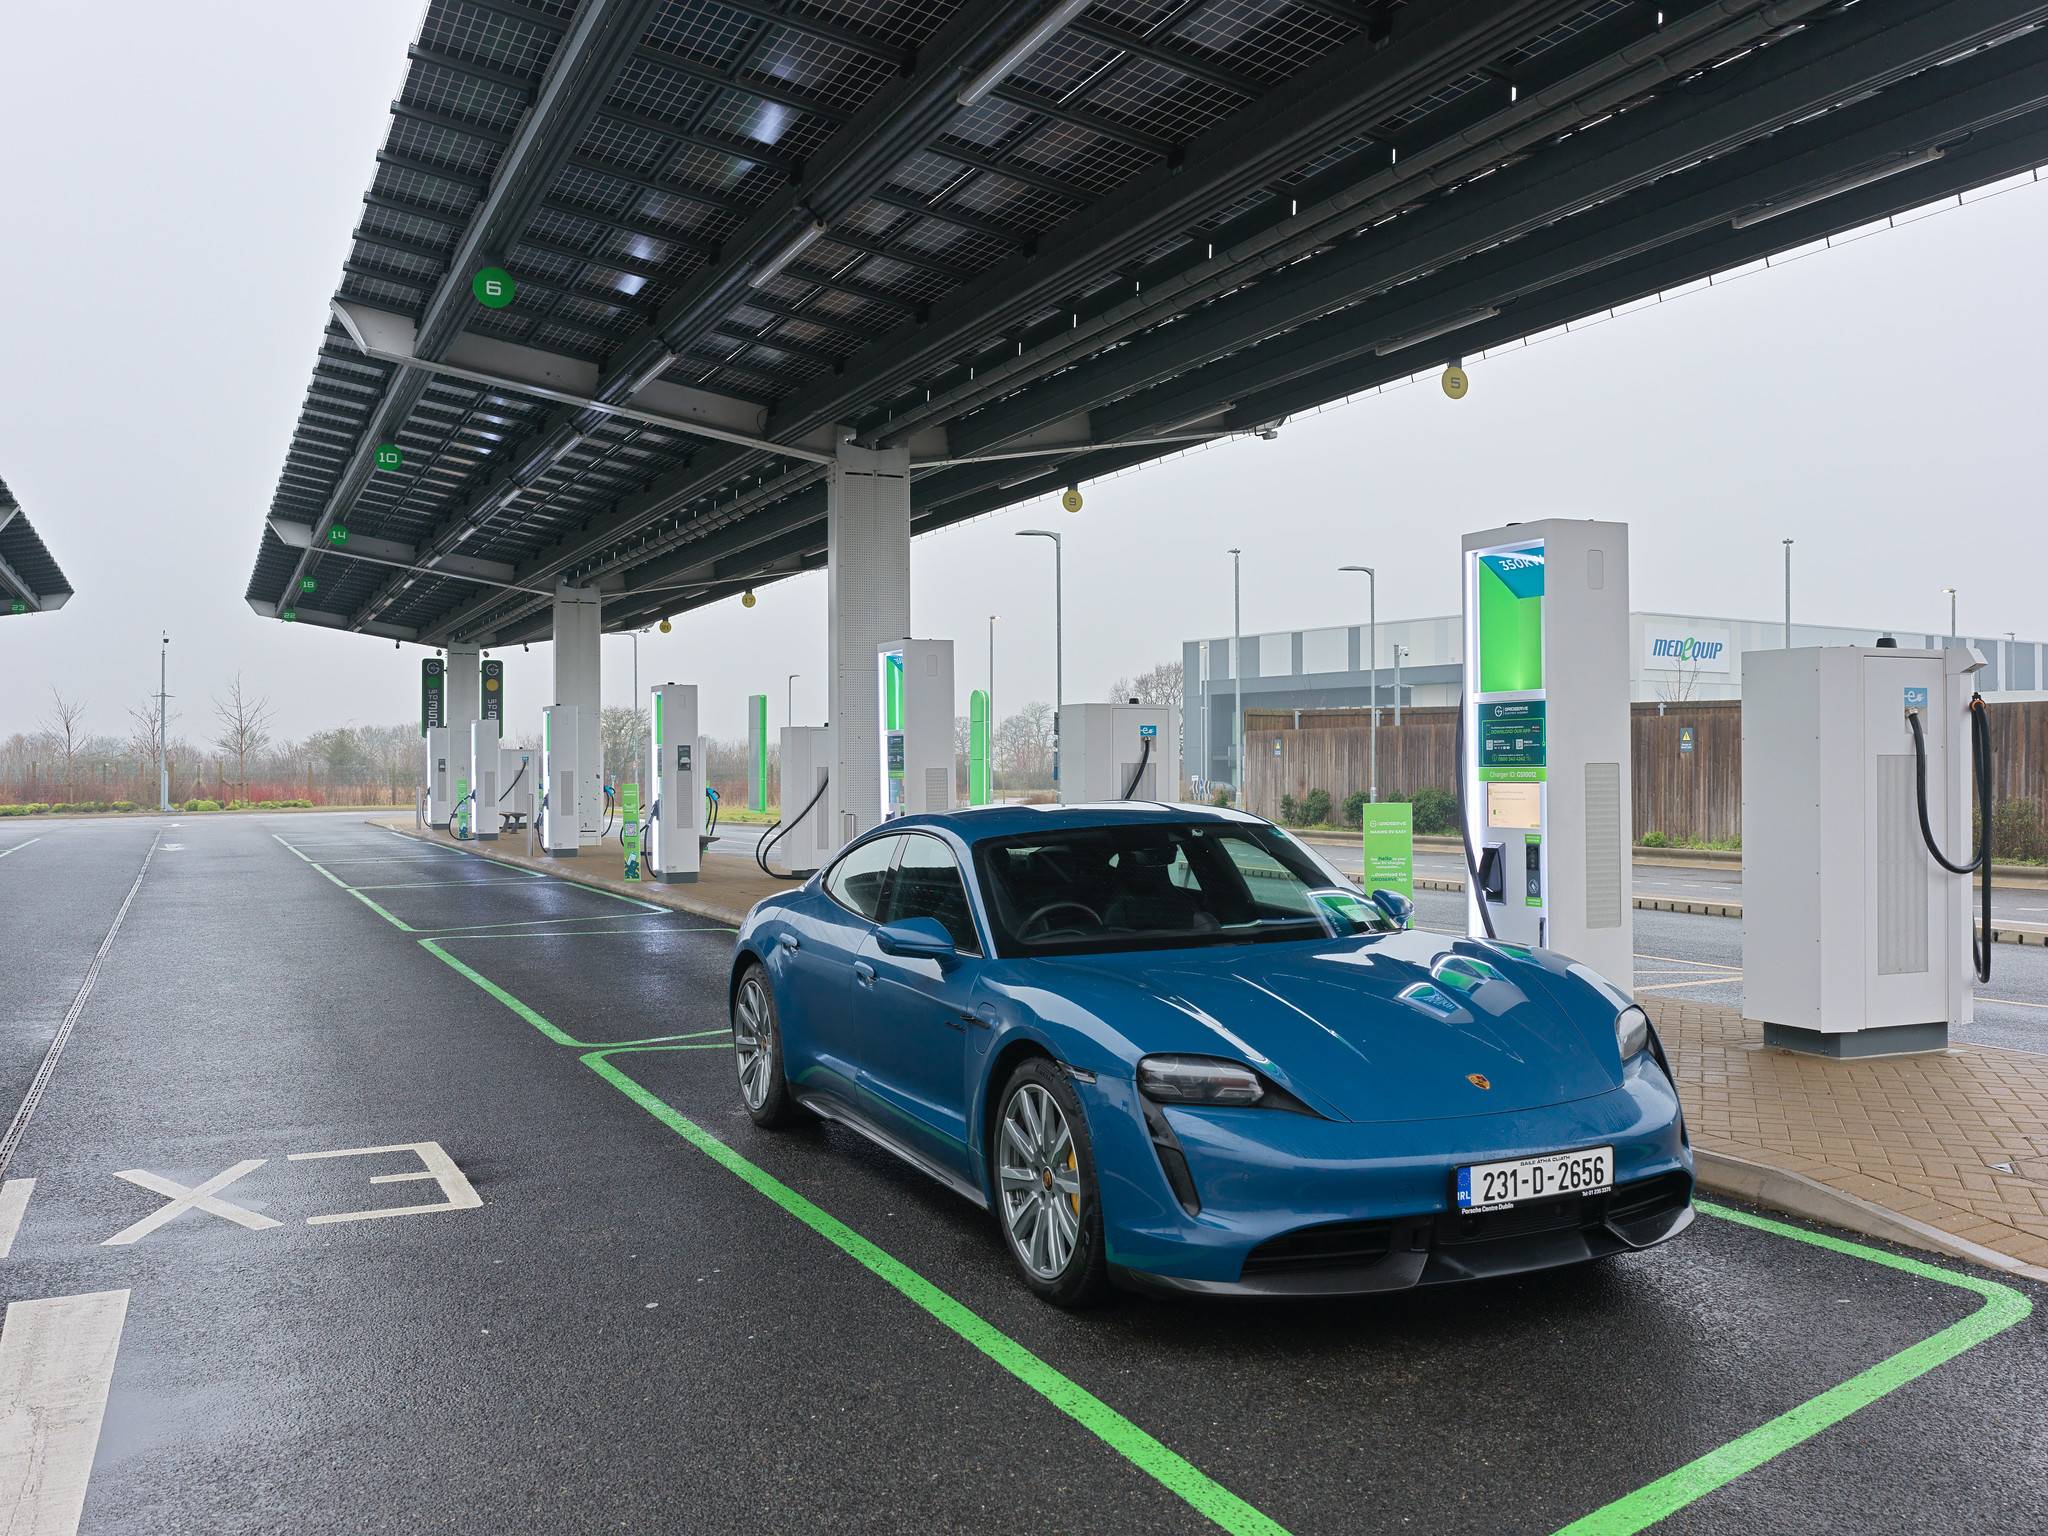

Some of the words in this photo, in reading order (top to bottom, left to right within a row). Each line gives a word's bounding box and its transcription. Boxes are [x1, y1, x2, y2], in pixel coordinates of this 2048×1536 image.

[486, 280, 502, 296] 6
[1451, 377, 1461, 388] 5
[378, 452, 398, 463] 10
[332, 530, 346, 540] 14
[1483, 1156, 1604, 1202] 231-D-2656
[1458, 1191, 1471, 1200] IRL
